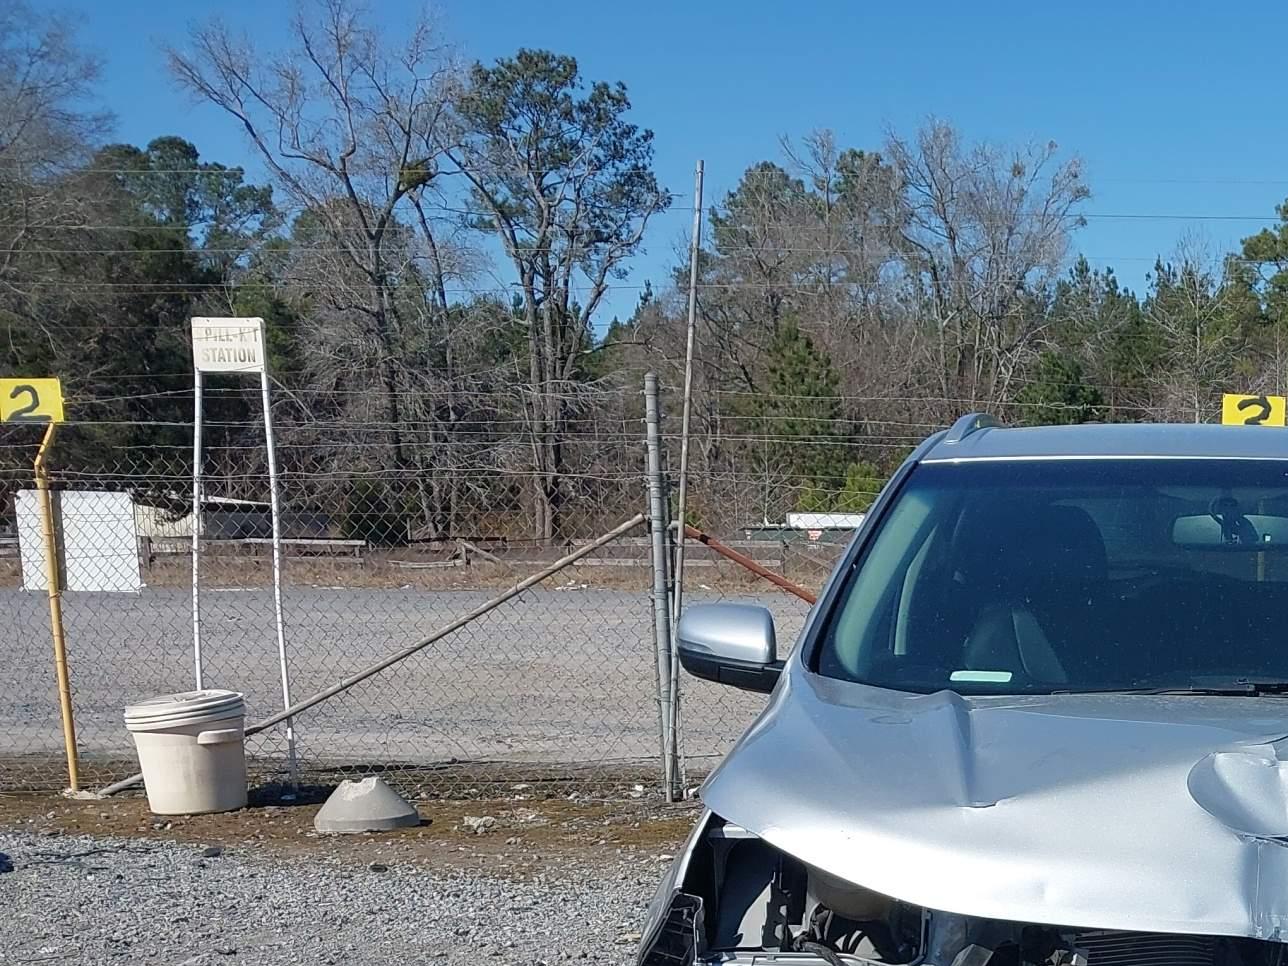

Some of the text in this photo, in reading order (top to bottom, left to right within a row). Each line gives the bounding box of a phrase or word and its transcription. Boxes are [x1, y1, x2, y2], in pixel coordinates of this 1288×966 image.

[202, 348, 257, 363] STATION
[7, 384, 53, 422] 2
[1237, 396, 1272, 426] 2
